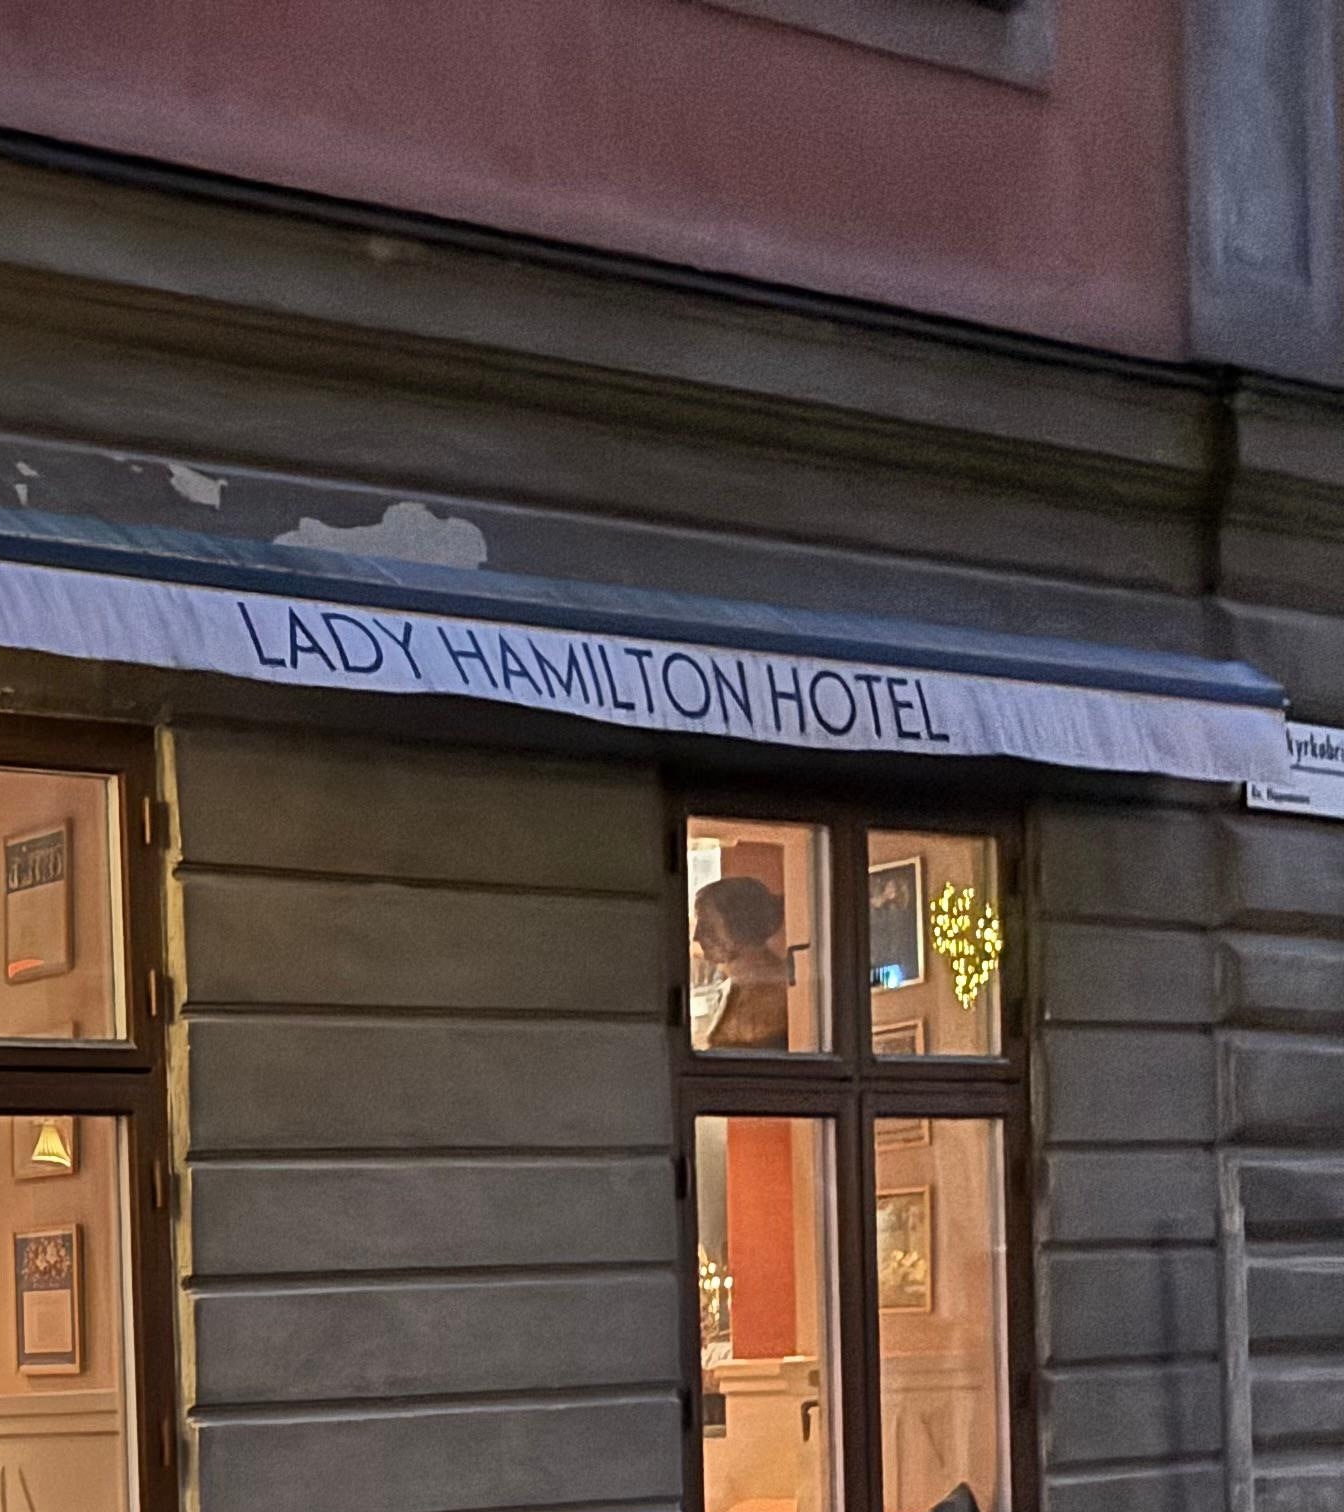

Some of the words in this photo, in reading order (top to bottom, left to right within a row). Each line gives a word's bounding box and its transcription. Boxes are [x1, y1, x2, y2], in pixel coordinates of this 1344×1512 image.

[237, 601, 421, 680] LADY
[437, 625, 754, 728] HAMILTON
[767, 664, 950, 742] HOTEL
